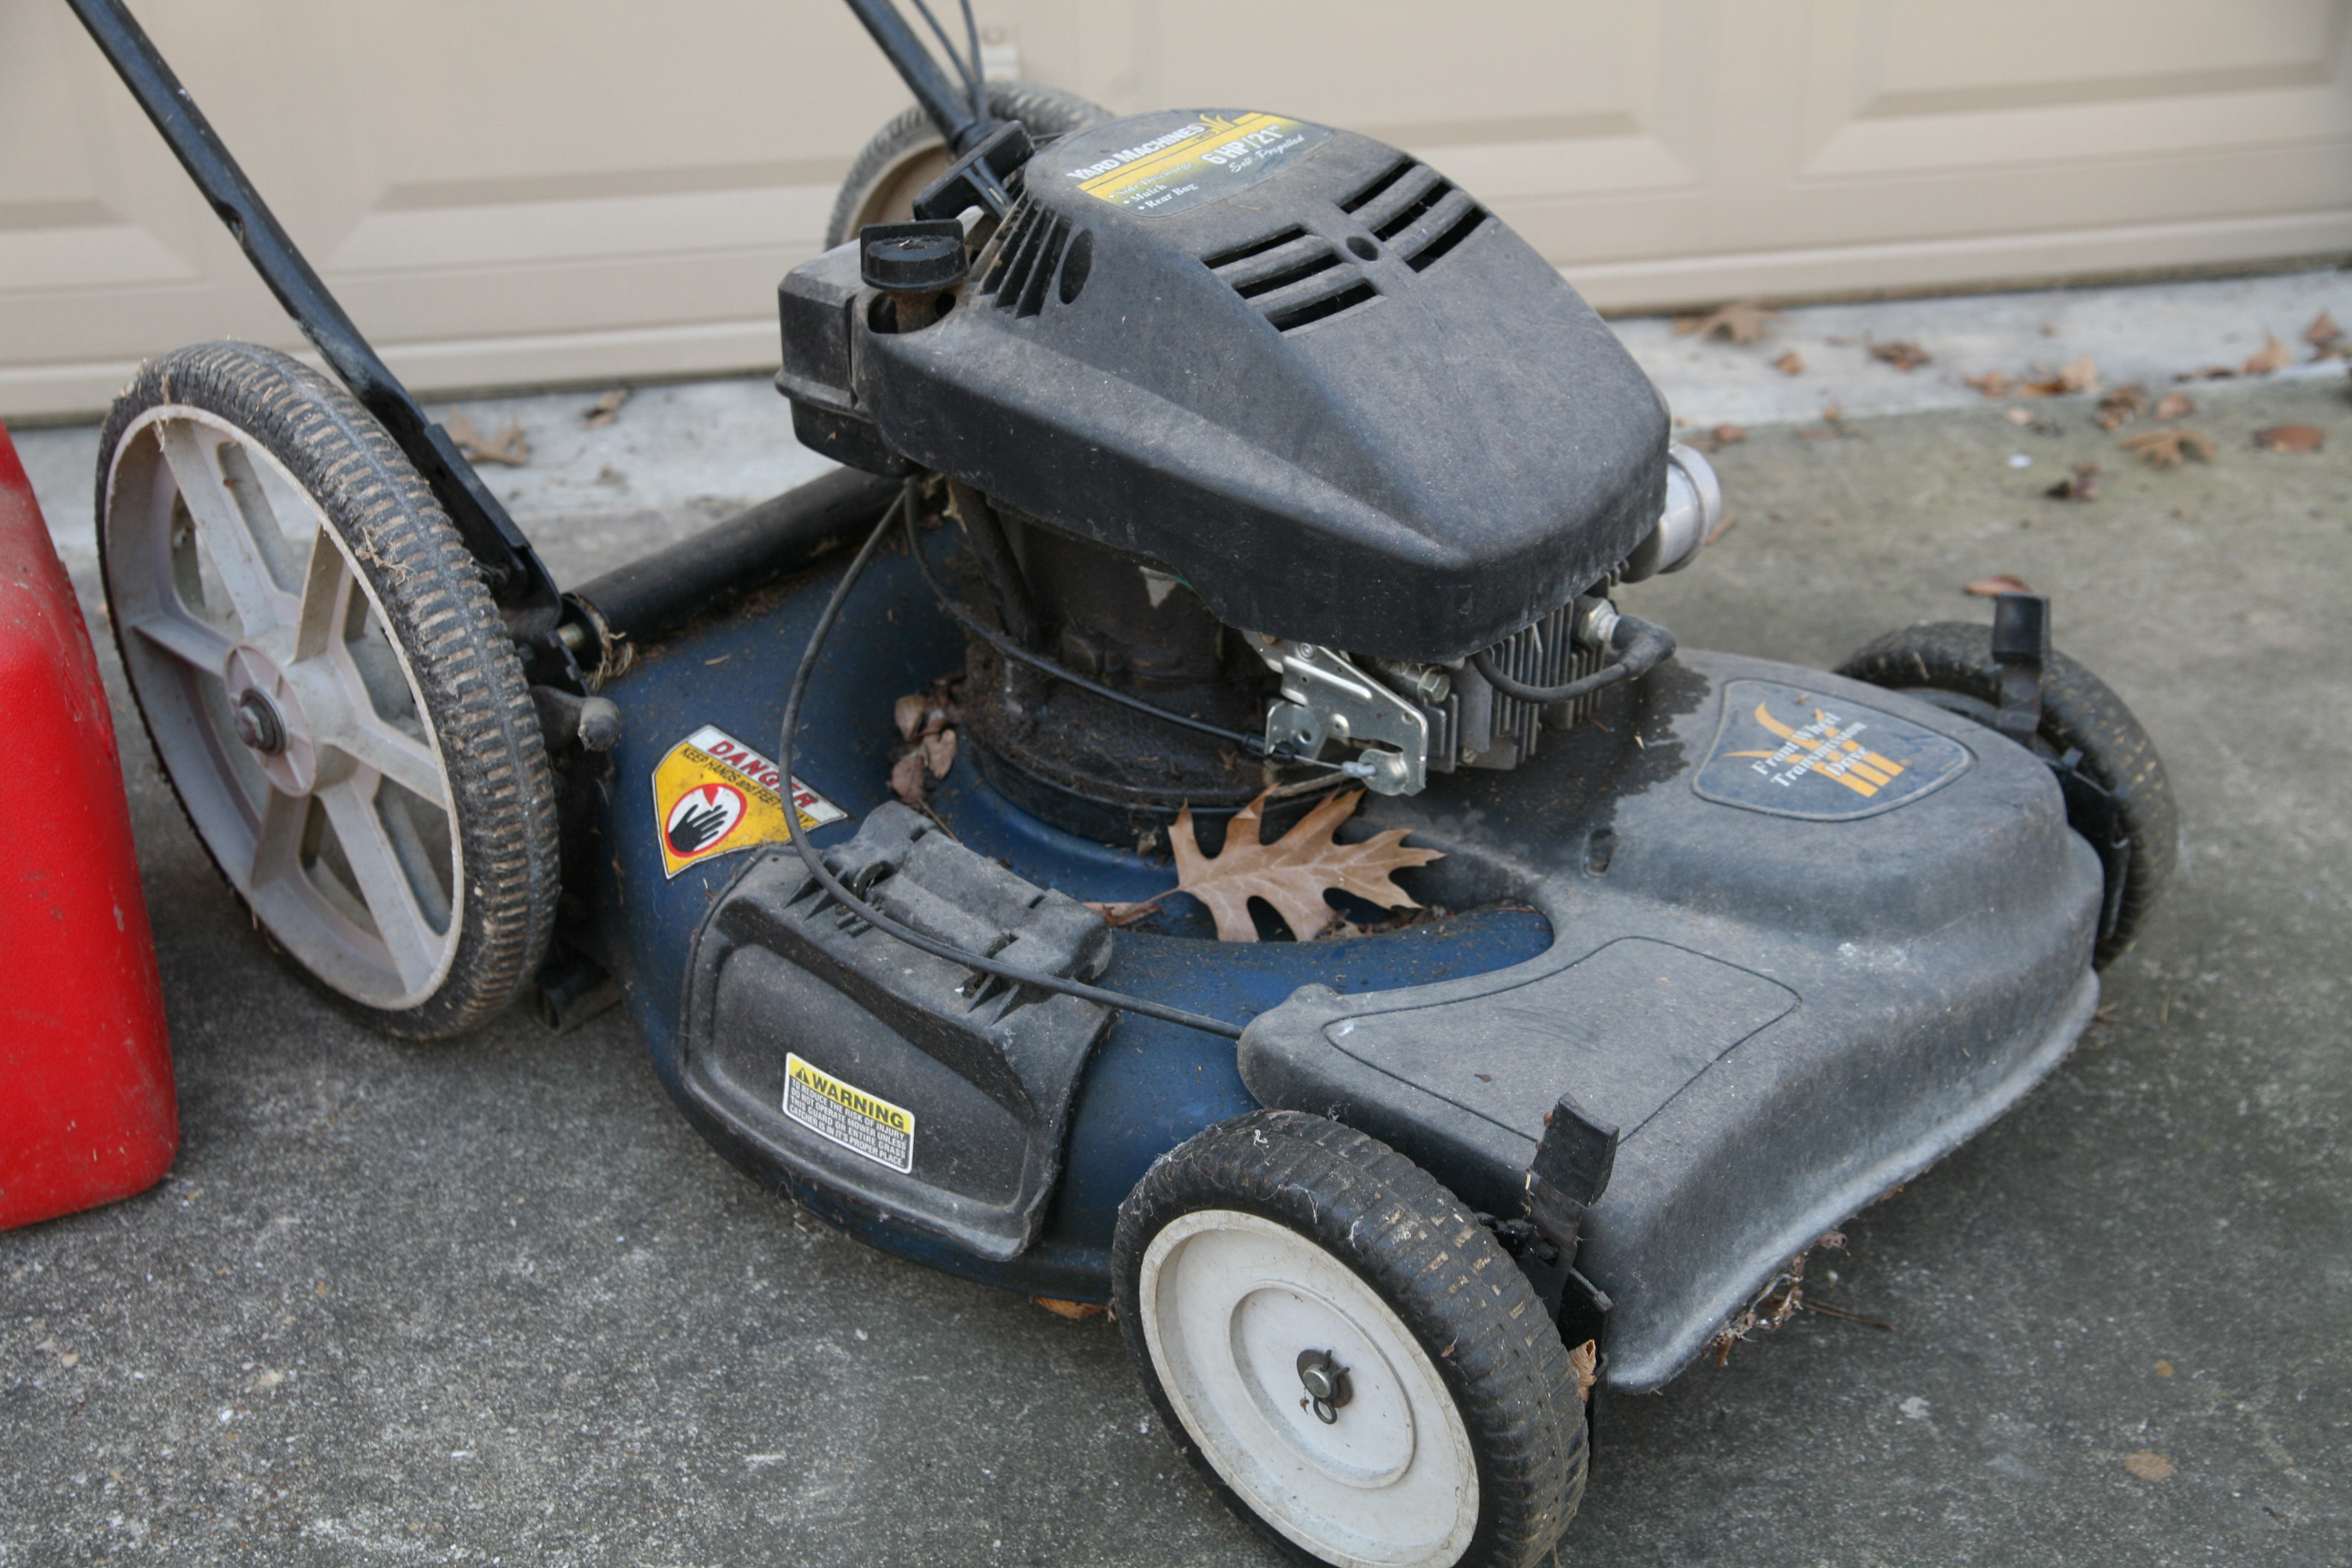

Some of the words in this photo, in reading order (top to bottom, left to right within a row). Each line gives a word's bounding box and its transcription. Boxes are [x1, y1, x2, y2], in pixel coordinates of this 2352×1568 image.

[1066, 158, 1120, 180] YARD
[1112, 125, 1205, 163] MACHINES
[1115, 183, 1141, 197] Side
[1140, 161, 1194, 186] Discharge
[1200, 153, 1227, 164] 6
[1130, 183, 1168, 202] Mulch
[1144, 193, 1173, 209] Rear
[1172, 183, 1199, 197] Bag
[1751, 740, 1800, 776] Front
[1791, 710, 1842, 741] Wheel
[1770, 721, 1867, 788] Transmission
[1823, 745, 1871, 777] Drive
[682, 747, 708, 763] KEEP
[705, 760, 741, 783] HANDS
[736, 778, 757, 793] and
[753, 788, 782, 806] FEET
[790, 1094, 806, 1111] THIS
[807, 1104, 834, 1126] GUARD
[834, 1118, 846, 1133] OR
[847, 1128, 876, 1148] ENTIRE
[877, 1138, 906, 1160] GRASS
[791, 1077, 800, 1091] TO
[801, 1082, 829, 1107] REDUCE
[829, 1100, 844, 1116] THE
[844, 1106, 863, 1123] RISK
[863, 1116, 875, 1128] OF
[791, 1086, 800, 1099] DO
[801, 1092, 814, 1107] NOT
[814, 1097, 846, 1123] OPERATE
[846, 1117, 876, 1138] MOWER
[876, 1129, 906, 1151] UNLESS
[812, 1073, 905, 1131] WARNING
[789, 1104, 818, 1127] CATCHER
[818, 1120, 826, 1132] IS
[826, 1125, 834, 1136] IN
[834, 1128, 848, 1143] IT'S
[849, 1135, 878, 1157] PROPER
[878, 1146, 905, 1167] PLACE.
